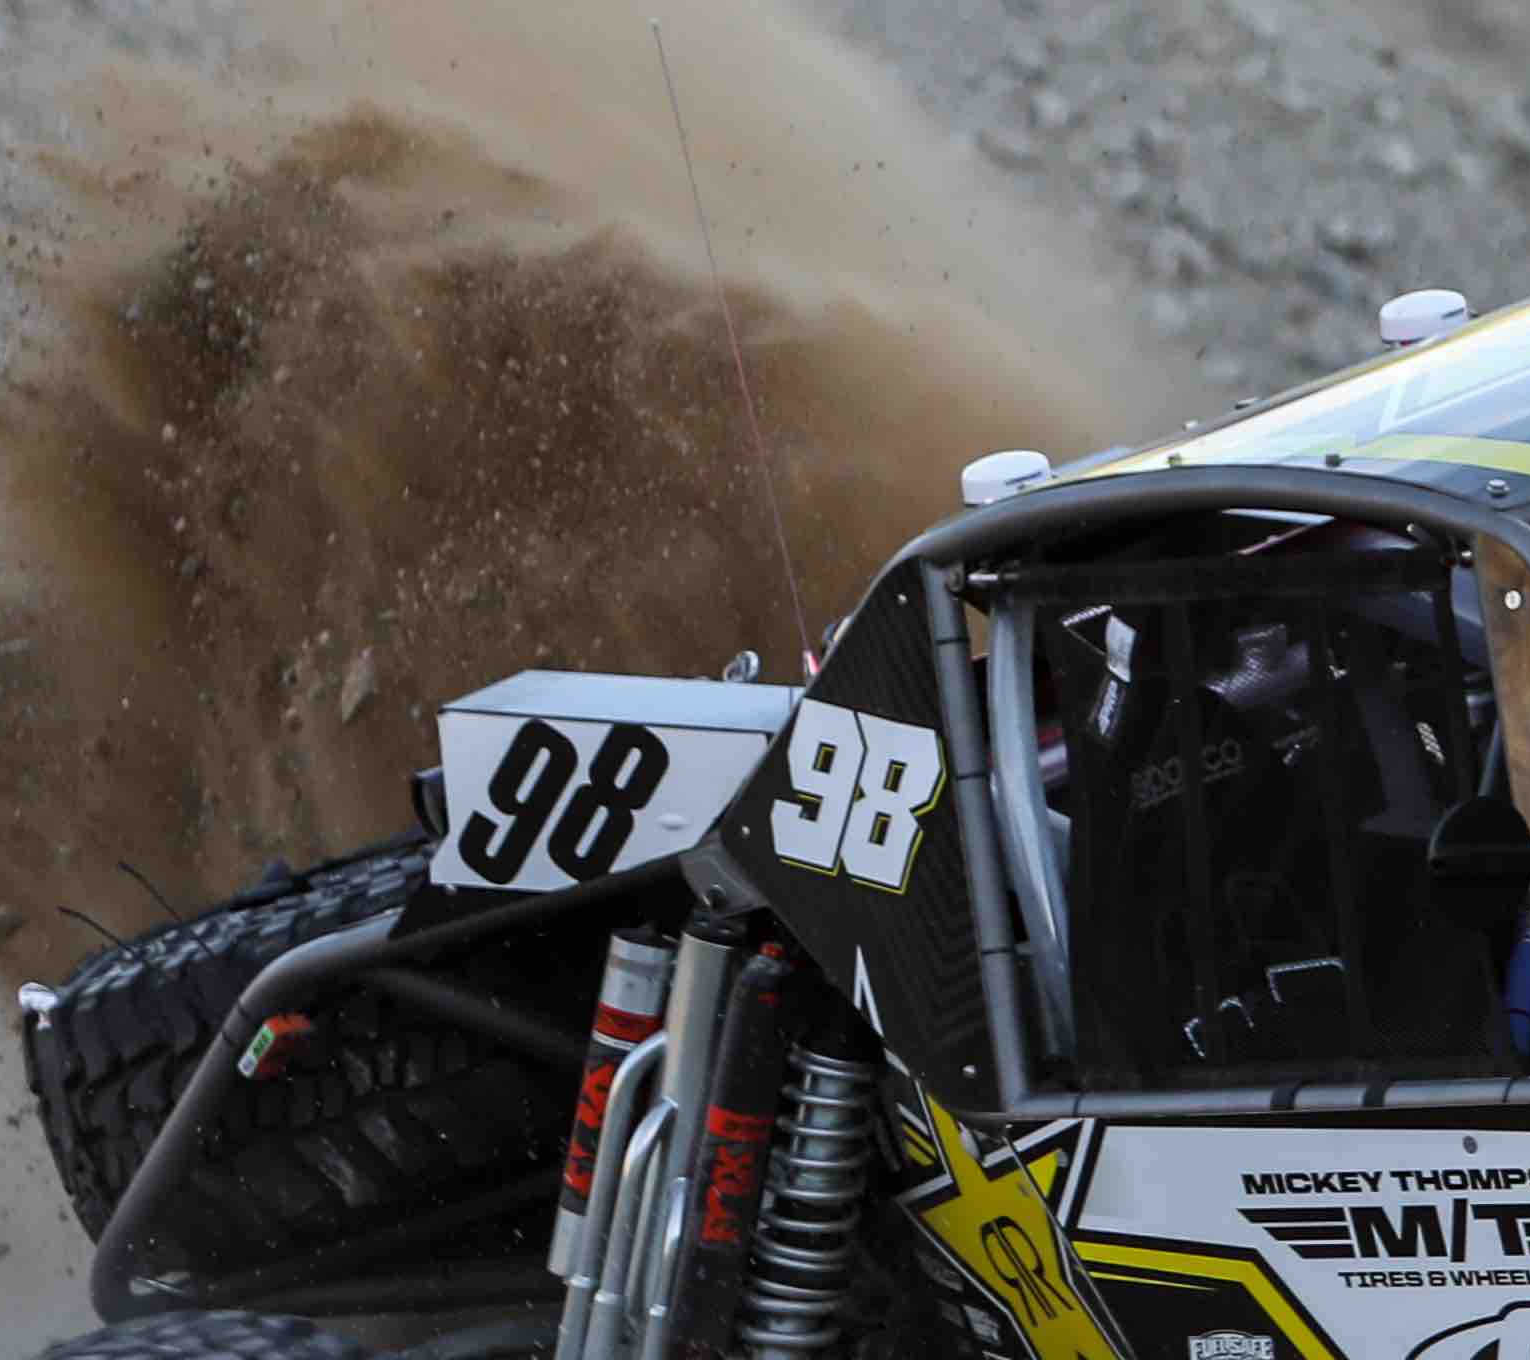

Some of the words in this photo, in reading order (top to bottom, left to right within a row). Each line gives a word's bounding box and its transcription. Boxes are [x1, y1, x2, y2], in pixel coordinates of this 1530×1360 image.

[458, 717, 670, 885] 98
[771, 697, 946, 893] 98
[1241, 1171, 1382, 1195] MICKEY
[1338, 1270, 1423, 1288] TIRES
[1427, 1270, 1447, 1287] &
